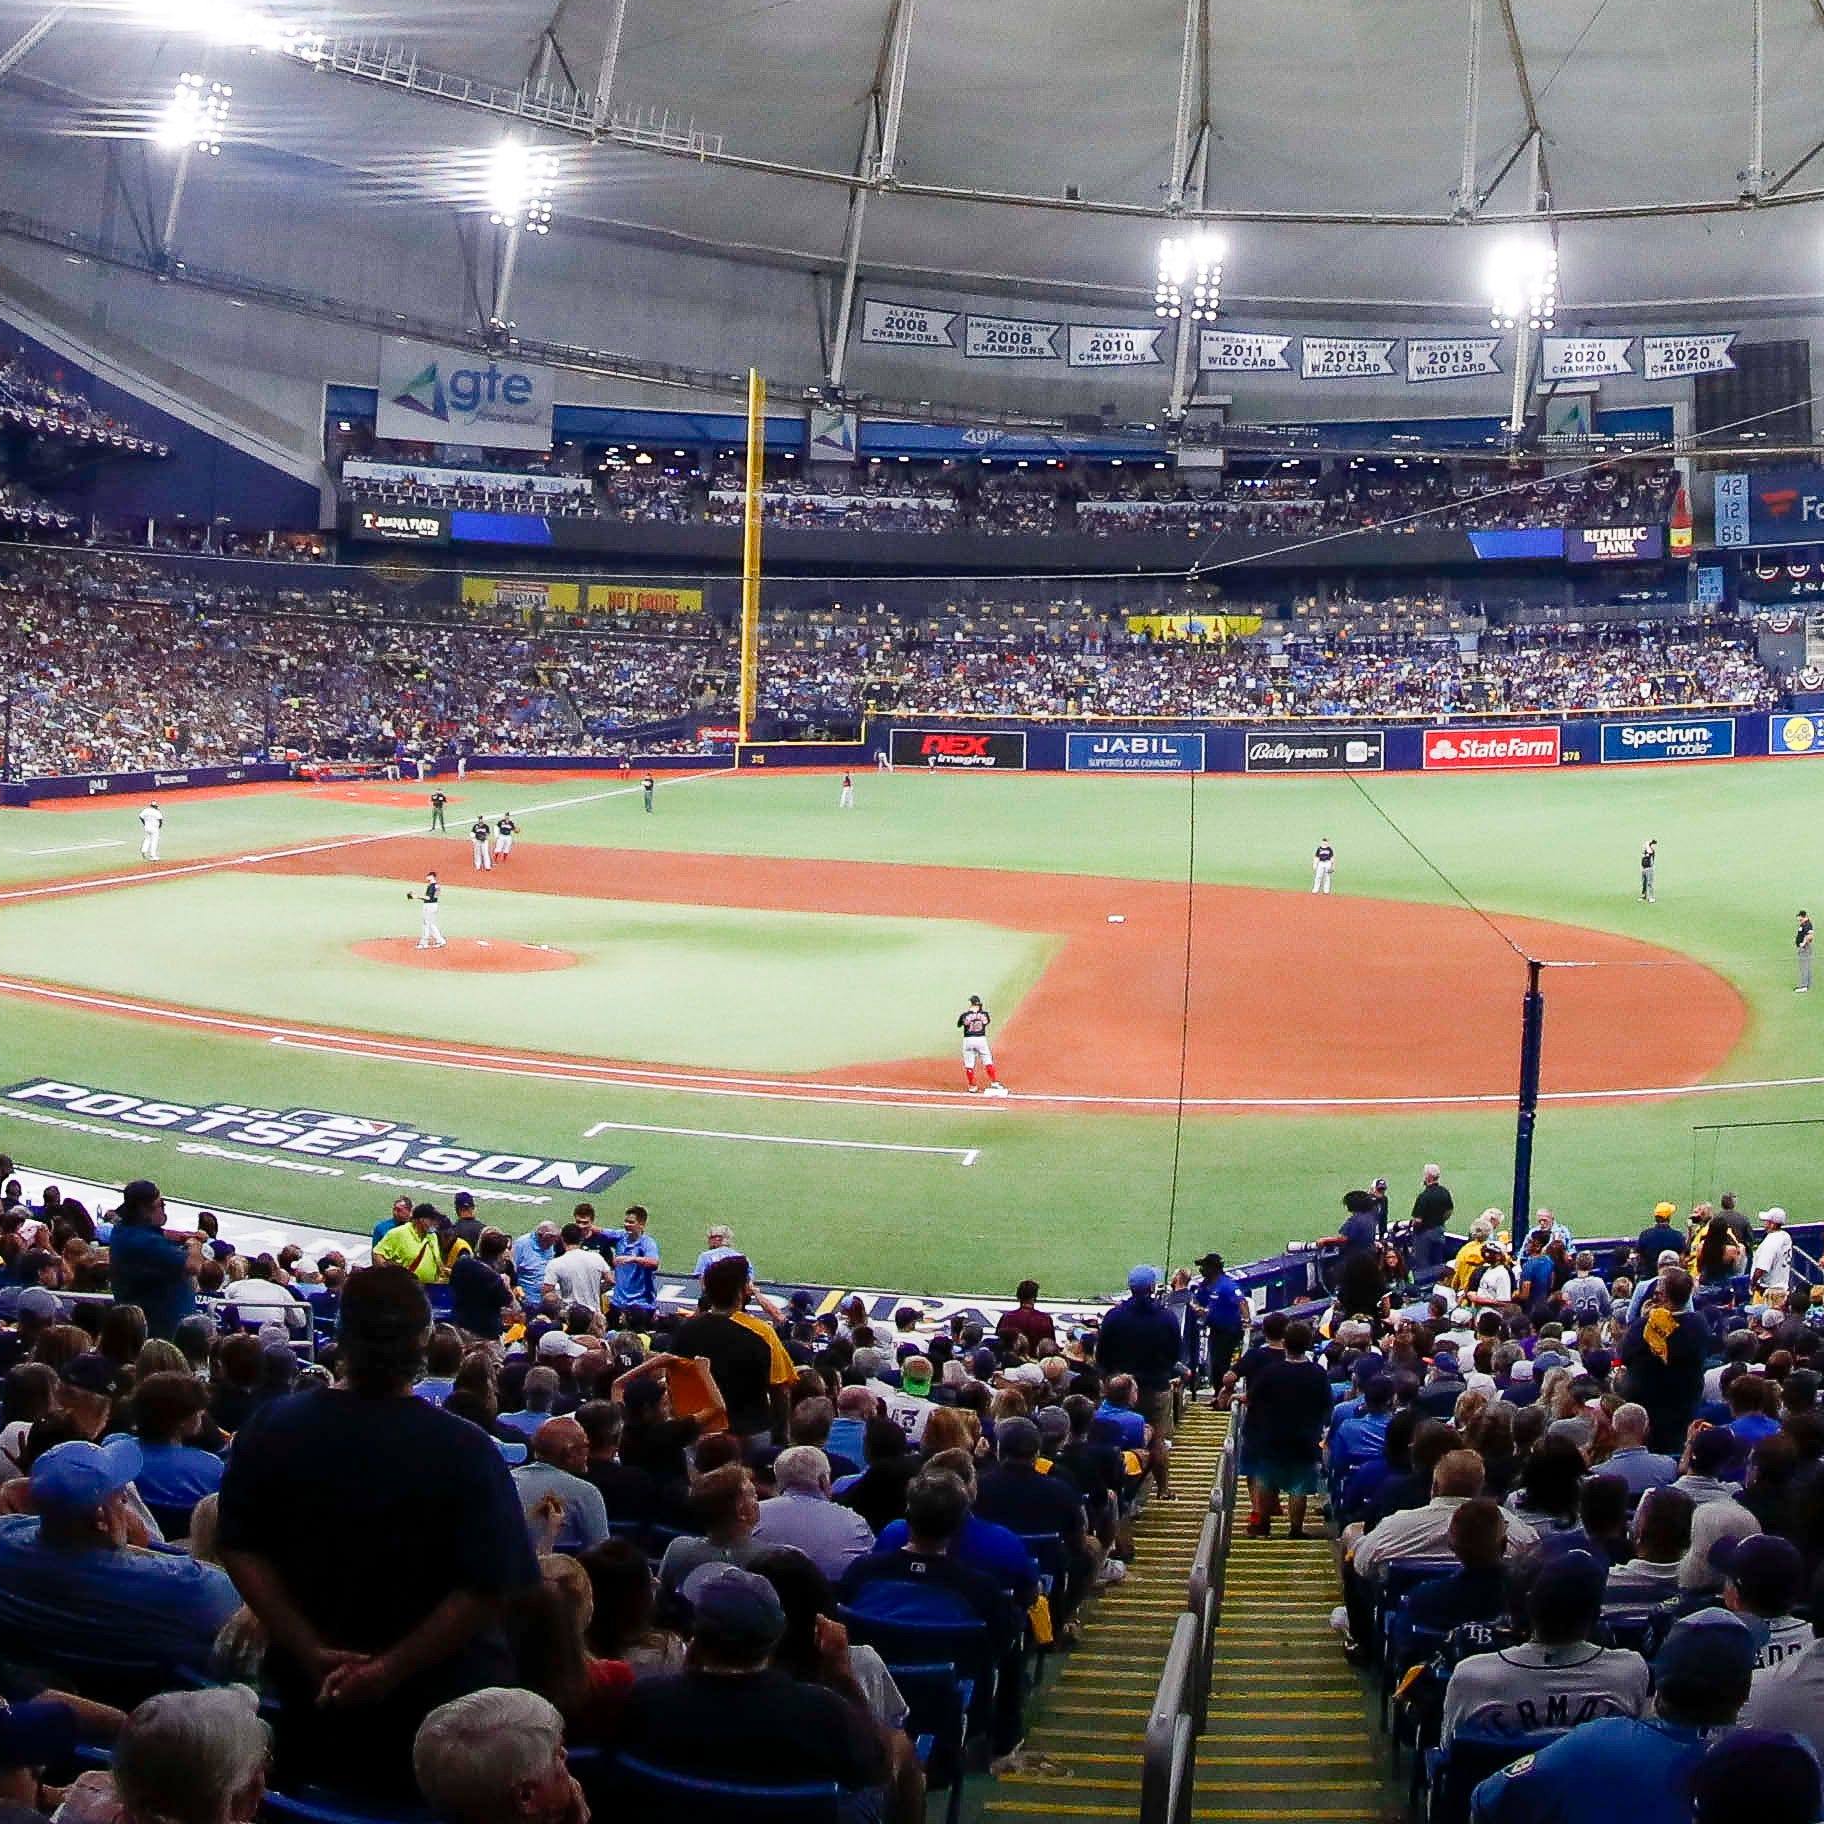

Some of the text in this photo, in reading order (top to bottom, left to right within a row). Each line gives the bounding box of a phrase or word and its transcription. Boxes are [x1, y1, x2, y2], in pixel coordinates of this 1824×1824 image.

[884, 316, 928, 333] 2008
[872, 328, 939, 344] CHAMPIONS
[986, 330, 1033, 345] 2008
[973, 343, 1045, 356] CHAMPIONS
[1090, 340, 1134, 352] 2010
[1221, 344, 1264, 358] 2011
[1078, 353, 1146, 362] CHAMPIONS
[1207, 356, 1277, 368] WILD CARD
[1324, 350, 1367, 364] 2013
[1427, 350, 1473, 365] 2019
[1563, 350, 1606, 364] 2020
[1663, 346, 1710, 363] 2020
[1311, 362, 1380, 374] WILD CARD
[1415, 362, 1486, 375] WILD CARD
[1552, 364, 1618, 374] CHAMPIONS
[1650, 359, 1724, 374] CHAMPIONS
[449, 363, 533, 412] gte
[1720, 480, 1742, 496] 42
[1583, 526, 1648, 544] REPUBLIC
[1596, 539, 1635, 555] BANK
[608, 589, 634, 610] HOT
[1622, 726, 1709, 749] Spectrum
[1093, 736, 1178, 755] JABIL
[1249, 742, 1295, 764] Bally
[1294, 746, 1329, 760] SPORTS
[1666, 742, 1707, 756] mobile
[936, 753, 997, 767] imaging
[7, 1080, 612, 1190] POSTSEASON
